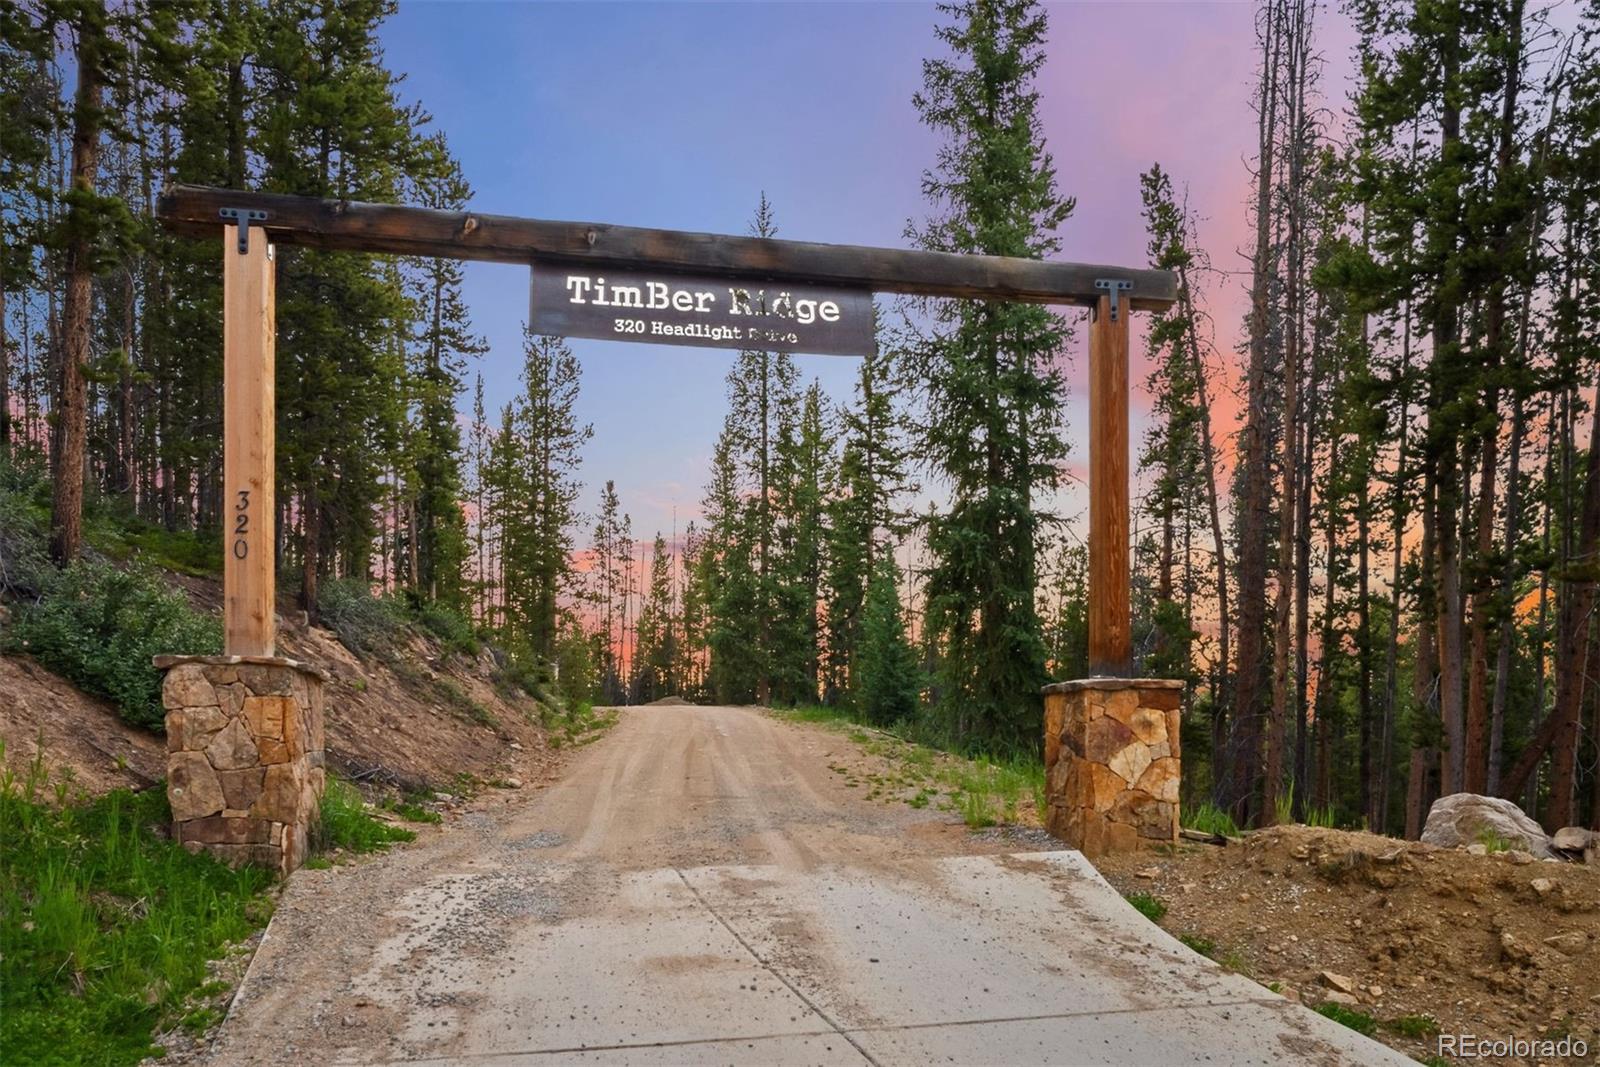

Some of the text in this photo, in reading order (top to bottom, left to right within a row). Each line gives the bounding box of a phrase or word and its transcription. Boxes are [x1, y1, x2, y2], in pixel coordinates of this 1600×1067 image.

[566, 275, 840, 324] TimBer Ridge
[613, 318, 798, 344] 320 Headlight Dive
[234, 490, 250, 560] 320
